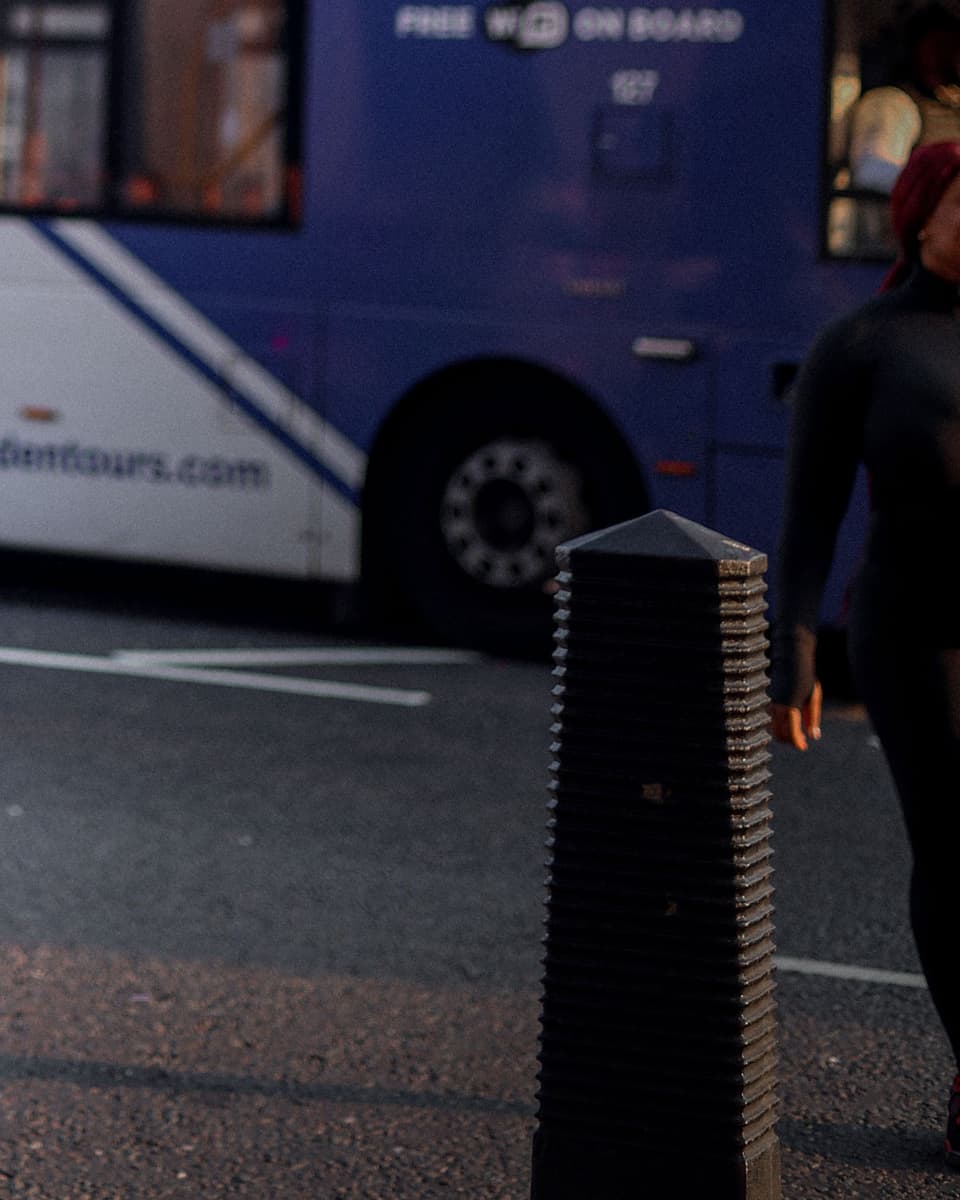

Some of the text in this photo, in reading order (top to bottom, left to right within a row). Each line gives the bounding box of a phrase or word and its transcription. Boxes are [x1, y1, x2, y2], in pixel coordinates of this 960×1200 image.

[396, 5, 474, 40] FREE
[574, 7, 625, 41] ON
[628, 7, 743, 43] BOARD
